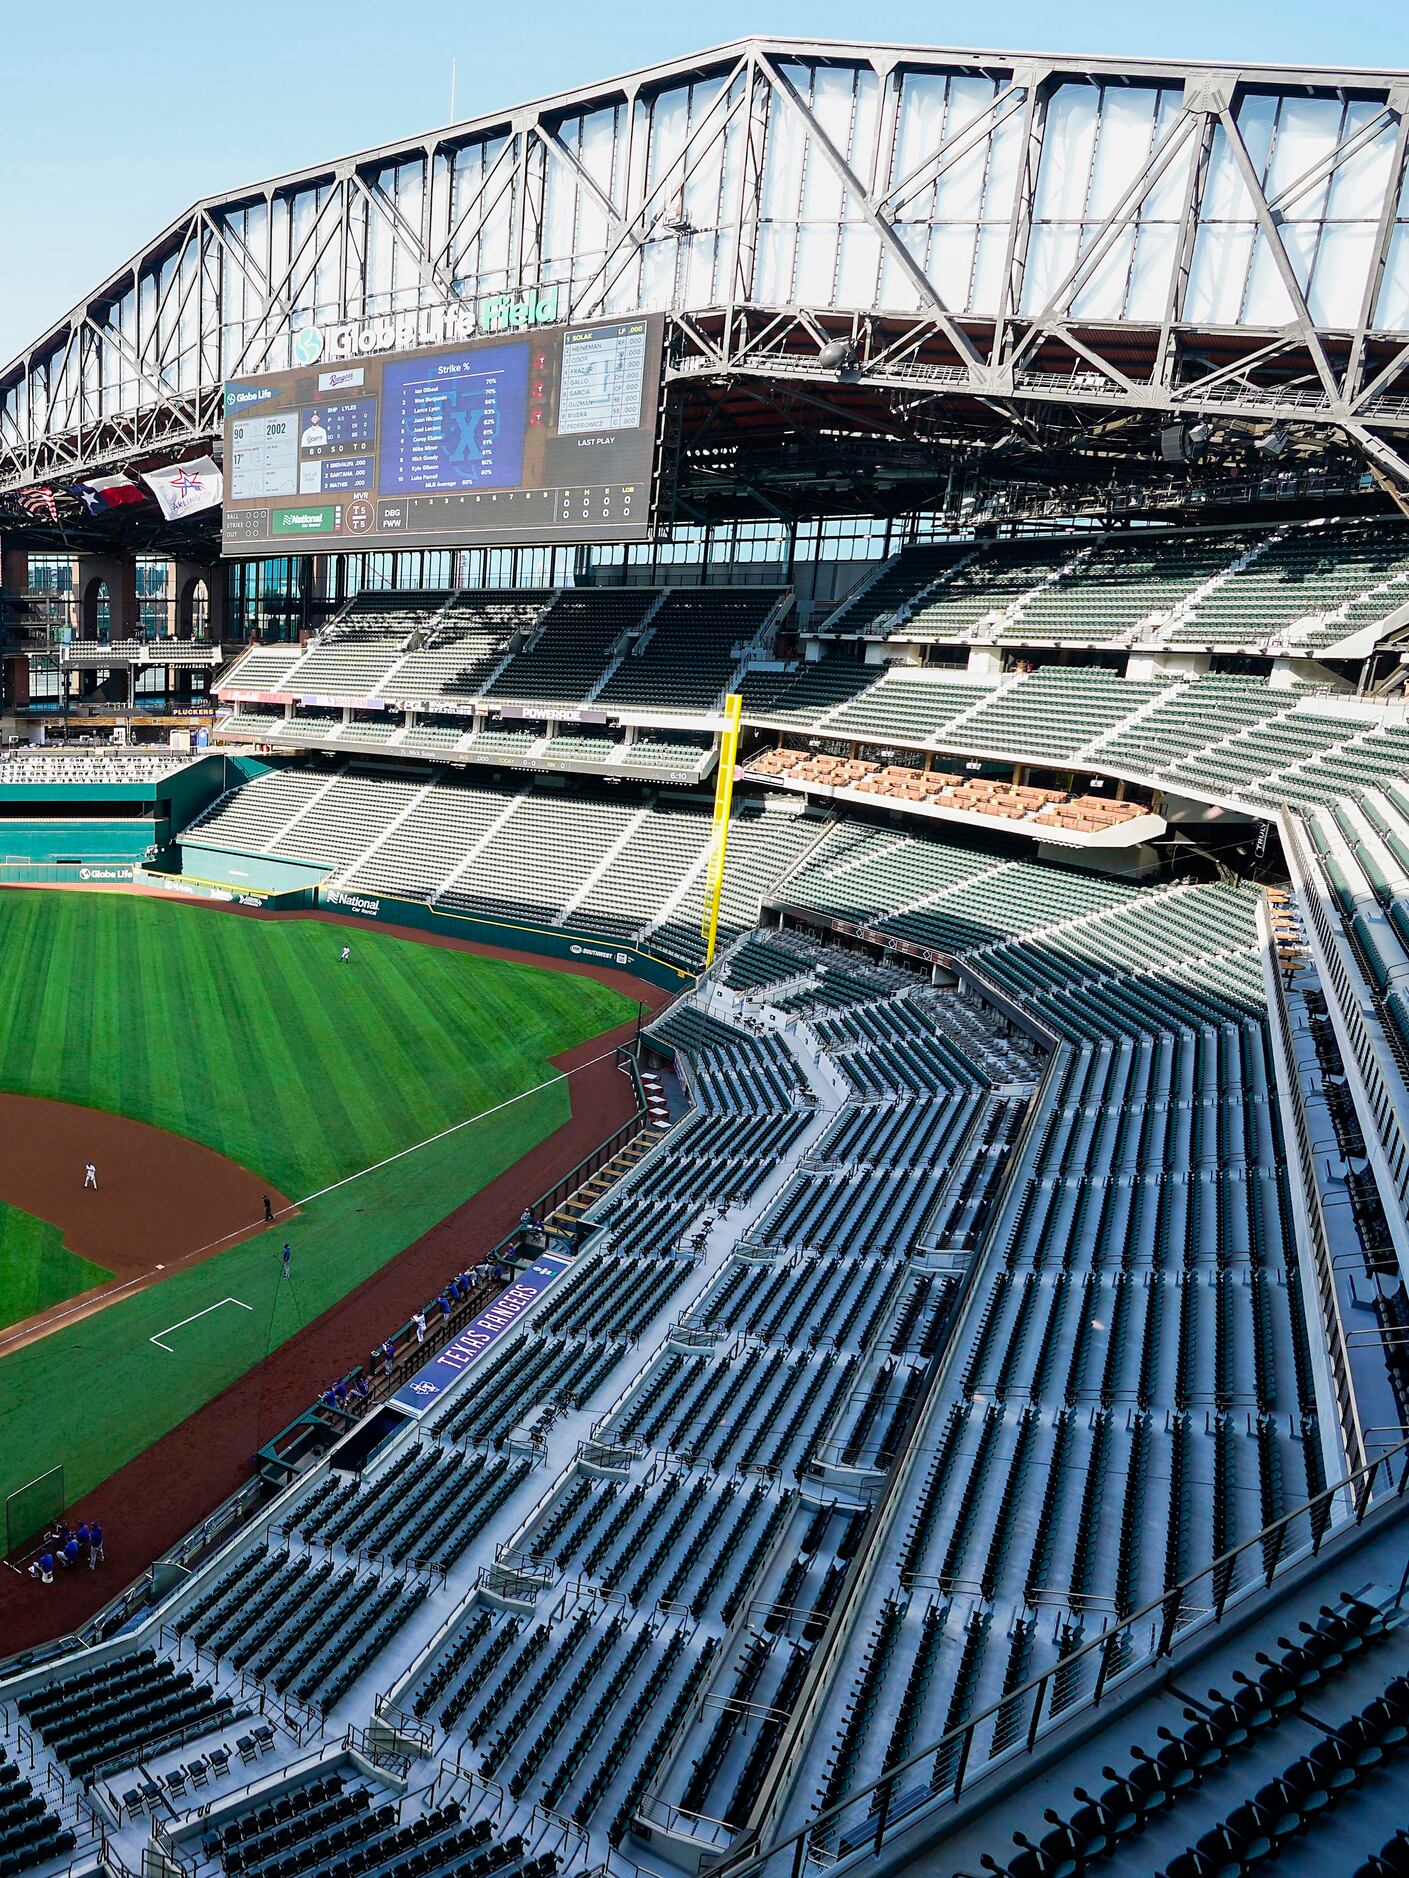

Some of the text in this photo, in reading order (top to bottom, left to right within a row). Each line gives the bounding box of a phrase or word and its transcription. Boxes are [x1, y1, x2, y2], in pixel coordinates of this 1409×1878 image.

[331, 287, 558, 355] Globe Life Field
[572, 343, 602, 352] HEINEMAN
[438, 362, 470, 374] Strike %
[328, 372, 353, 386] Rangers
[236, 390, 272, 402] Globe Life
[568, 400, 592, 408] GUZMAN
[234, 428, 244, 439] 90
[266, 422, 286, 436] 2002
[578, 437, 616, 446] LAST PLAY
[292, 513, 323, 524] National
[384, 509, 400, 517] DBG
[383, 520, 402, 528] FWW
[522, 708, 582, 720] POWERADE
[670, 772, 687, 780] 6:10
[1256, 824, 1267, 850] TRULY
[91, 870, 132, 879] Globe Life
[582, 948, 612, 958] SOUTHWEST
[436, 1284, 538, 1369] TEXAS RANGERS
